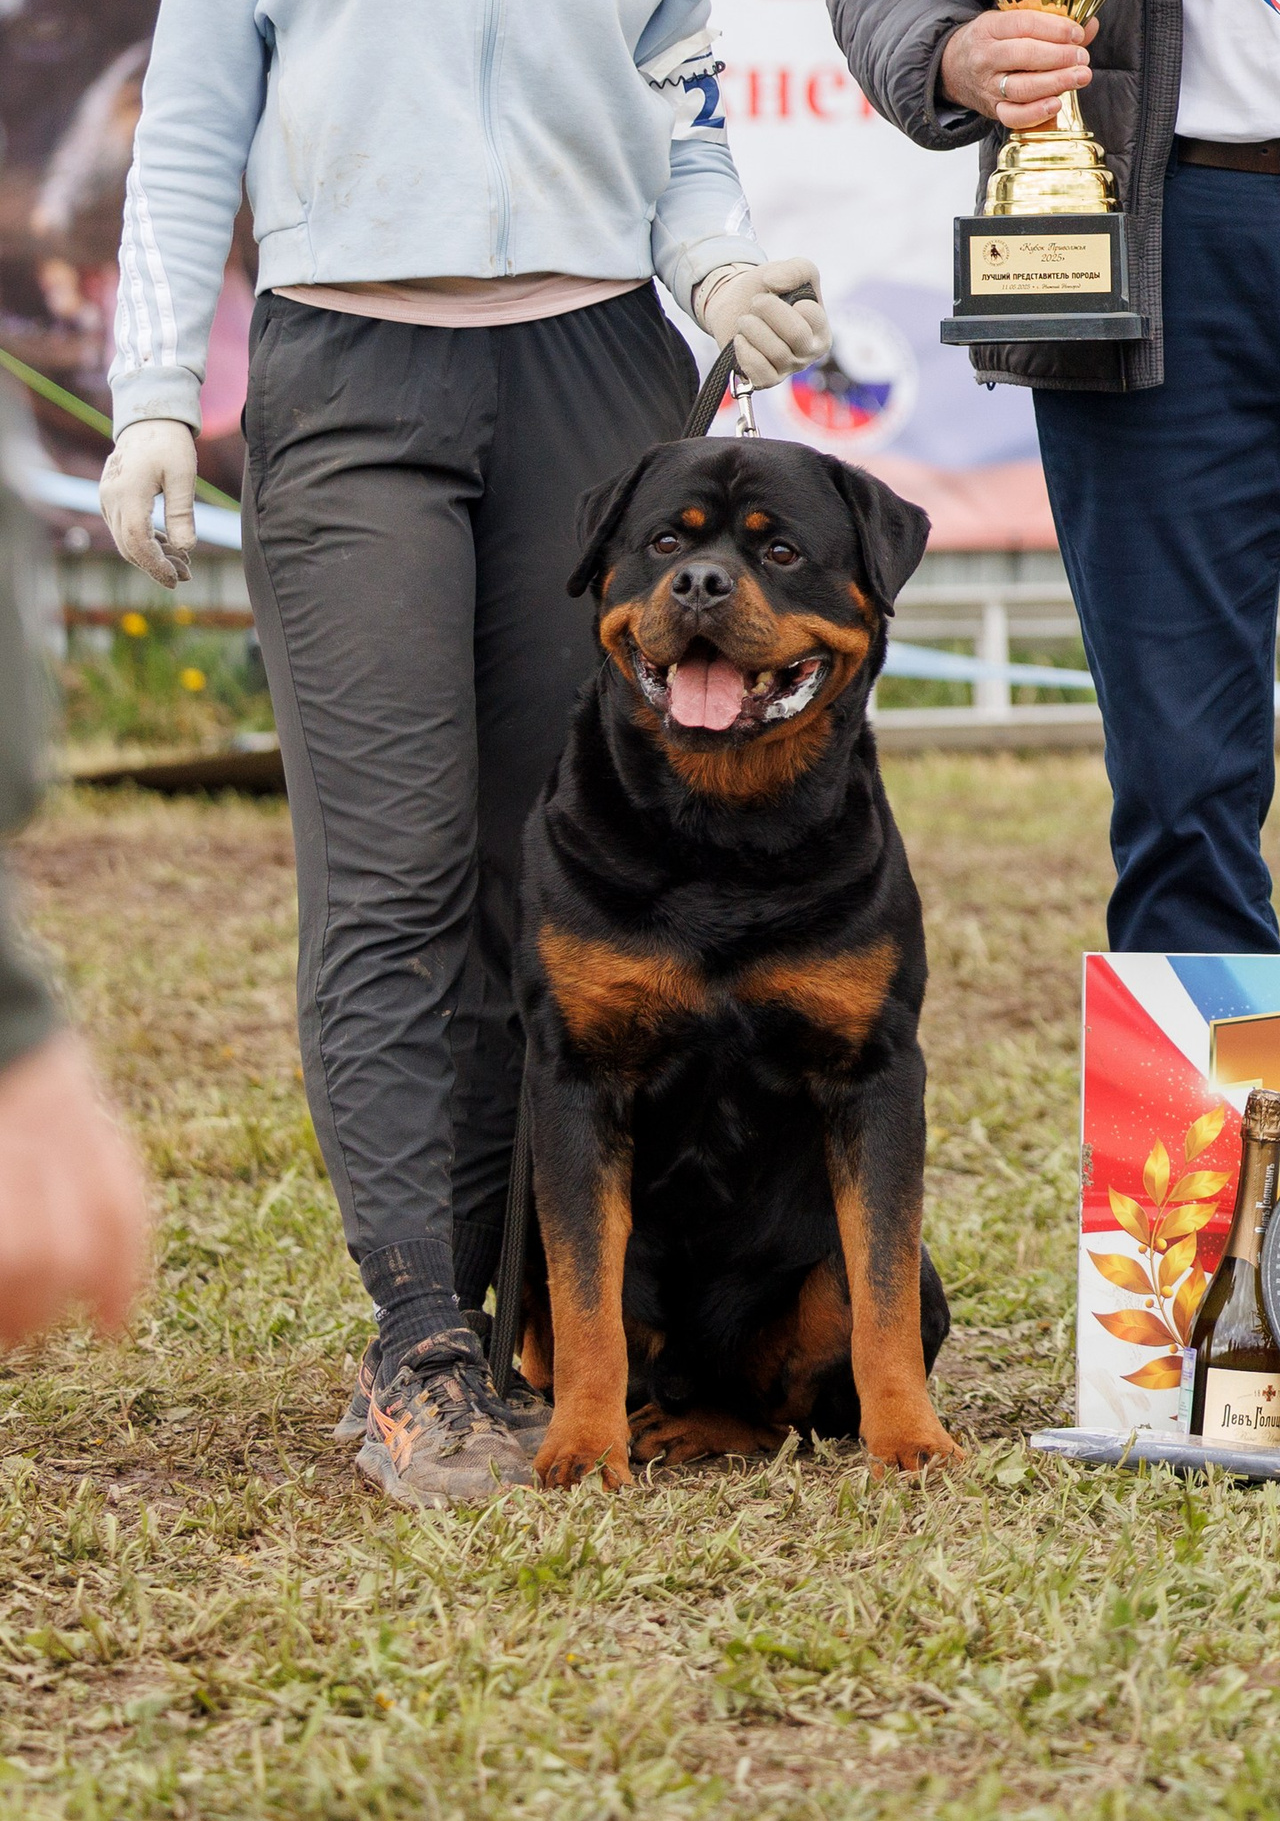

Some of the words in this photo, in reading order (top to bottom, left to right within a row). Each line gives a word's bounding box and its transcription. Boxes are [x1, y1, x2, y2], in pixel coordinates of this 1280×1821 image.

[981, 271, 1011, 281] ЛУЧШИЙ
[1012, 271, 1070, 281] ПРЕДСТАВИТЕЛЬ
[1071, 271, 1101, 280] ПОРОДЫ
[1221, 1403, 1252, 1428] Левъ
